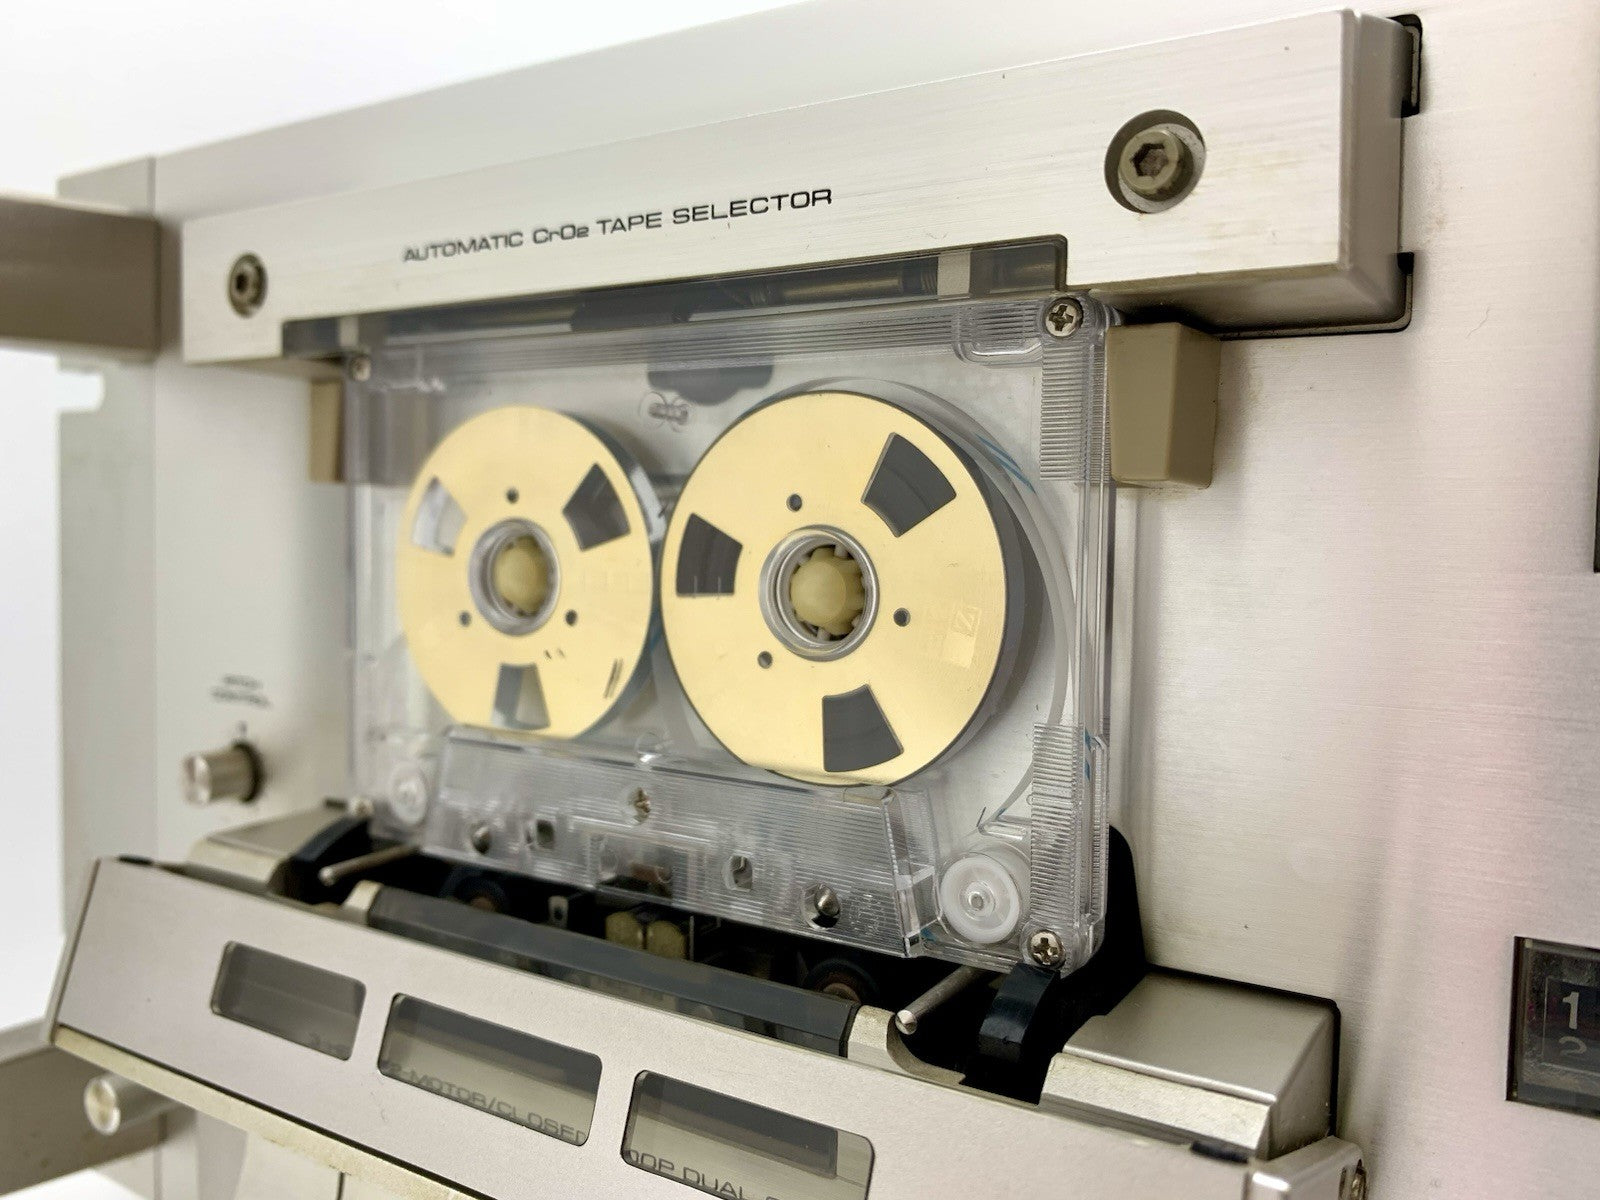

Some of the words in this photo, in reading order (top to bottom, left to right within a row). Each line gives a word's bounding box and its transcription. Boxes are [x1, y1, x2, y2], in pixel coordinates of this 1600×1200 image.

[404, 231, 523, 262] AUTOMATIC
[597, 211, 662, 235] TAPE
[673, 188, 832, 224] SELECTOR
[1562, 991, 1580, 1030] 1
